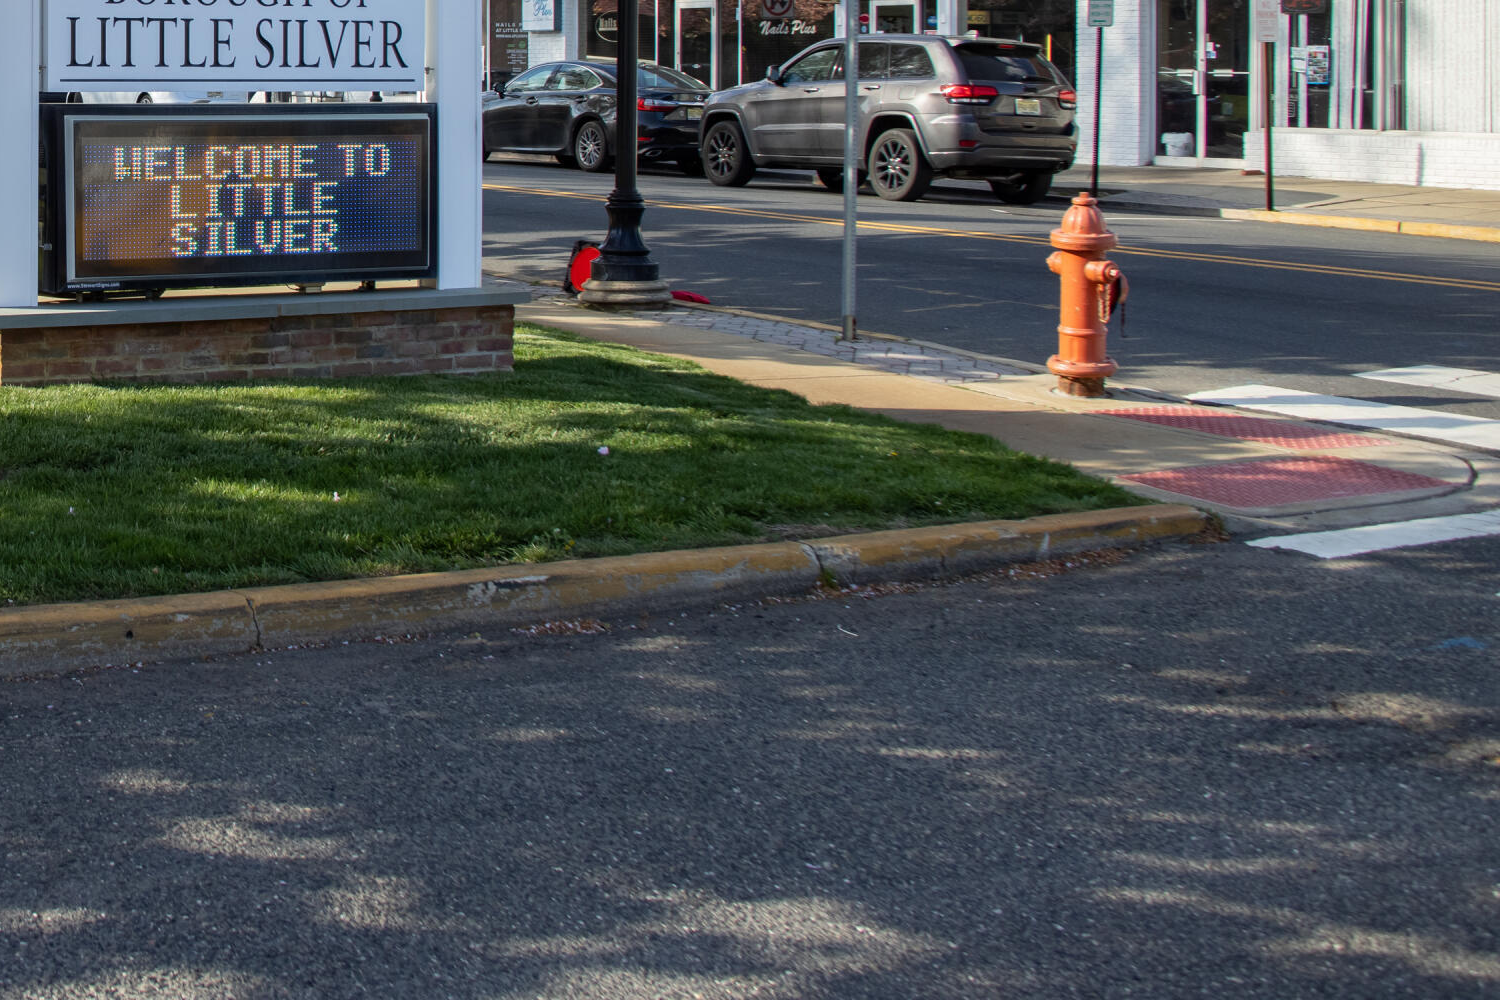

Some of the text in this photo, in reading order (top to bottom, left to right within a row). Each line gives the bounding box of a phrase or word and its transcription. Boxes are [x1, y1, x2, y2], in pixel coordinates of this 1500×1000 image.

[66, 16, 409, 69] LITTLE SILVER
[759, 19, 817, 36] Nails Plus
[114, 143, 391, 181] WELCOME TO
[169, 181, 339, 219] LITTLE
[169, 218, 339, 256] SILVER
